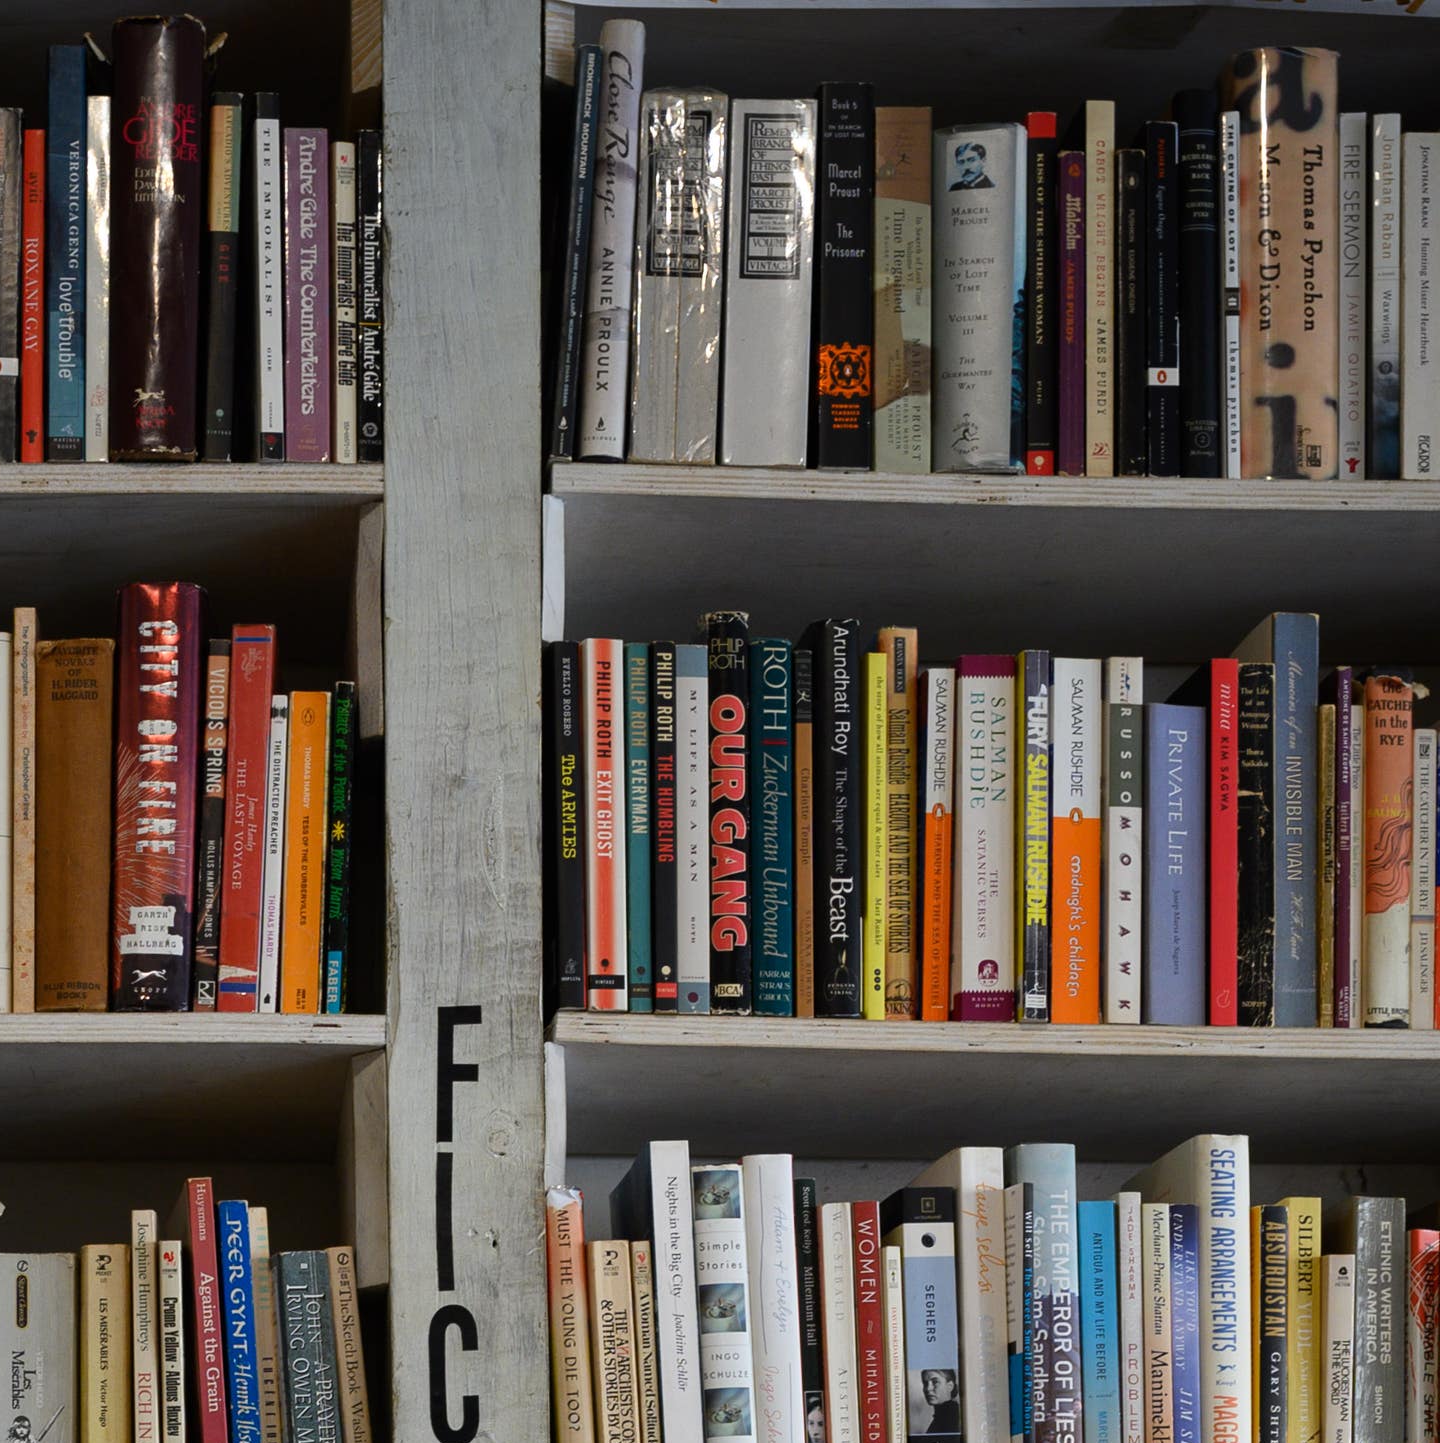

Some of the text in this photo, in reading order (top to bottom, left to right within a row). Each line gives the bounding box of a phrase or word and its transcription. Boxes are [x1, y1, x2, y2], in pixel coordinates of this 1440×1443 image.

[56, 140, 81, 378] VERONICA GENG love trouble
[1301, 145, 1323, 332] Thomas Pynchon
[1419, 238, 1430, 366] Hunting Mister Heartbreak
[595, 248, 614, 391] ANNIE PROULX
[762, 646, 788, 957] ROTH Zuckerman Unbound
[1219, 684, 1234, 811] mina KIM SAGWA
[711, 694, 746, 952] OUR GANG
[1210, 1149, 1235, 1218] SEATING
[1211, 1227, 1237, 1352] ARRANGEMENTS
